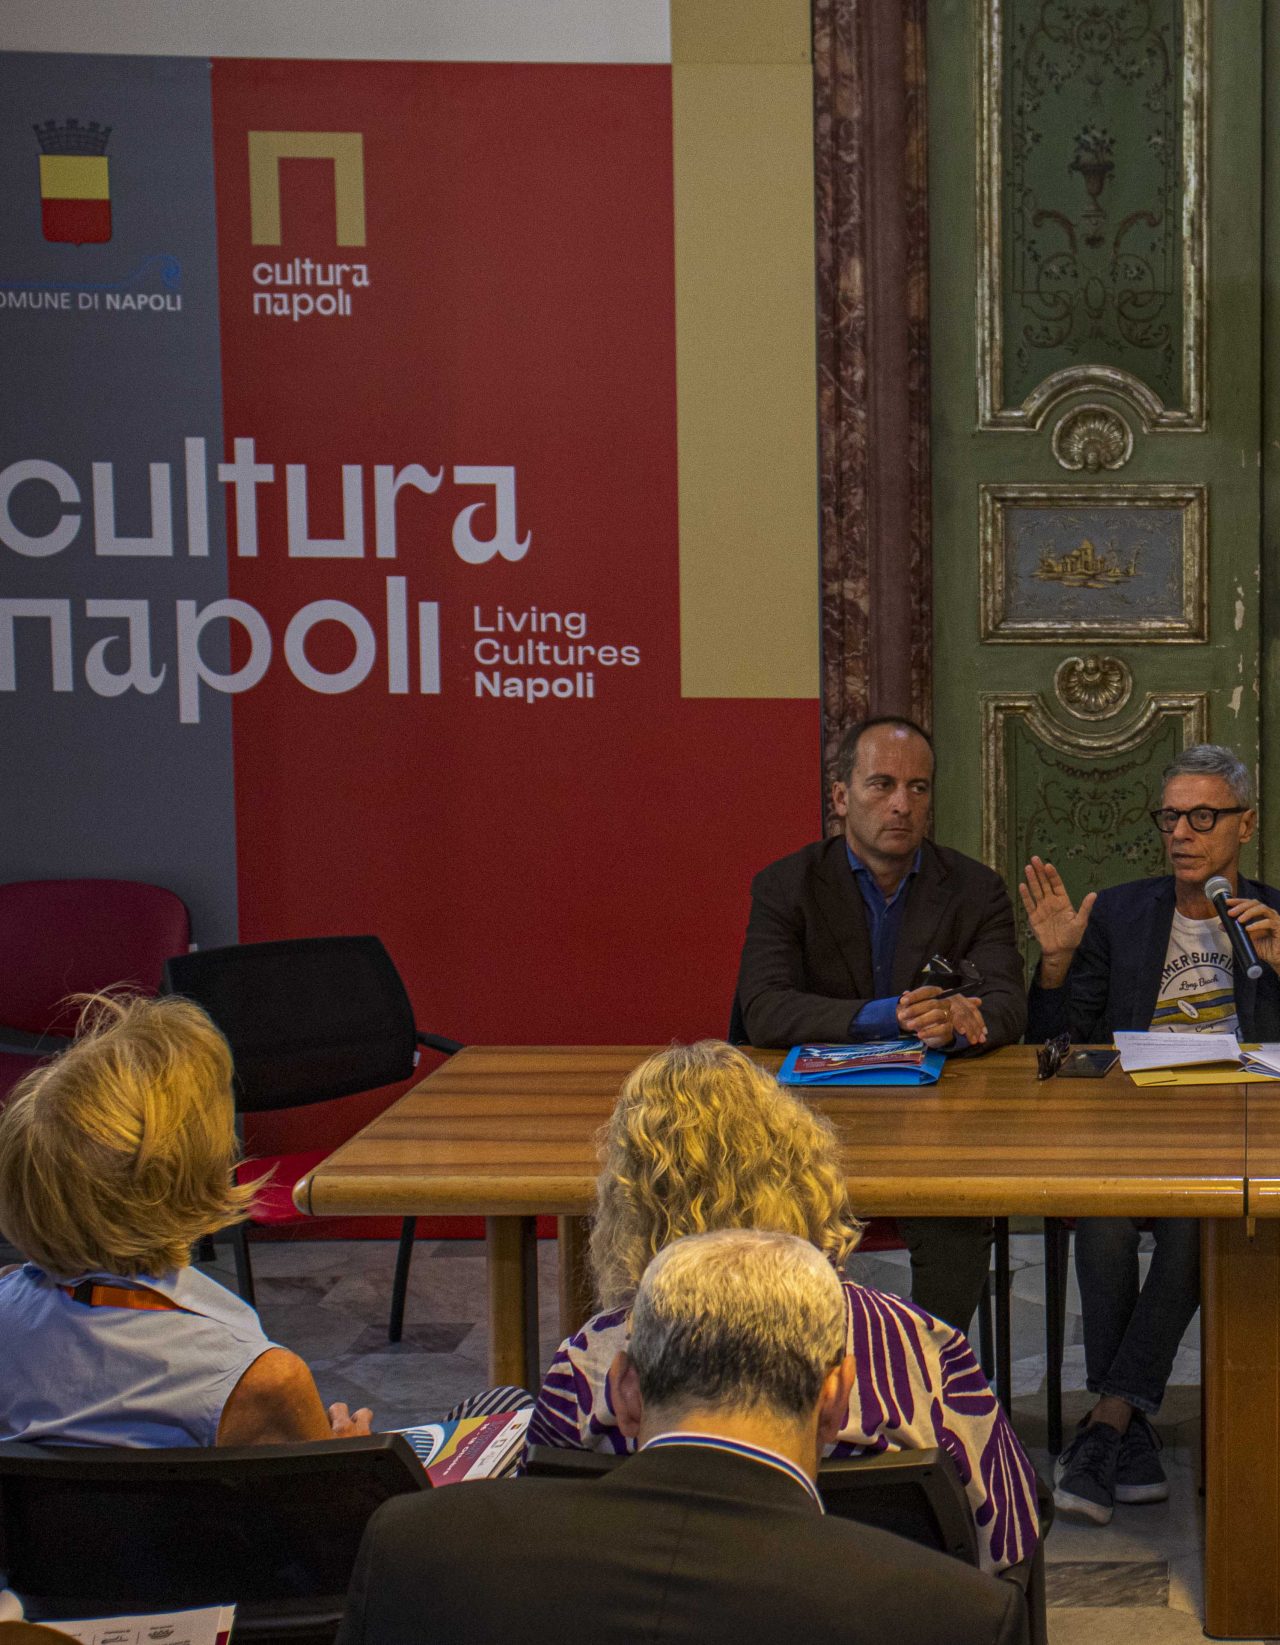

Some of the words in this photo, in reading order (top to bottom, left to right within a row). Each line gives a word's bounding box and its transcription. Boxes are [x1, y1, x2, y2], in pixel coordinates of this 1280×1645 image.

[252, 257, 370, 287] cultura
[78, 292, 99, 309] DI
[106, 293, 182, 311] NAPOLI
[253, 288, 352, 322] napoli
[0, 436, 532, 564] cultura
[473, 605, 587, 639] Living
[0, 576, 441, 723] napoli
[474, 638, 641, 666] Cultures
[474, 671, 595, 704] Napoli
